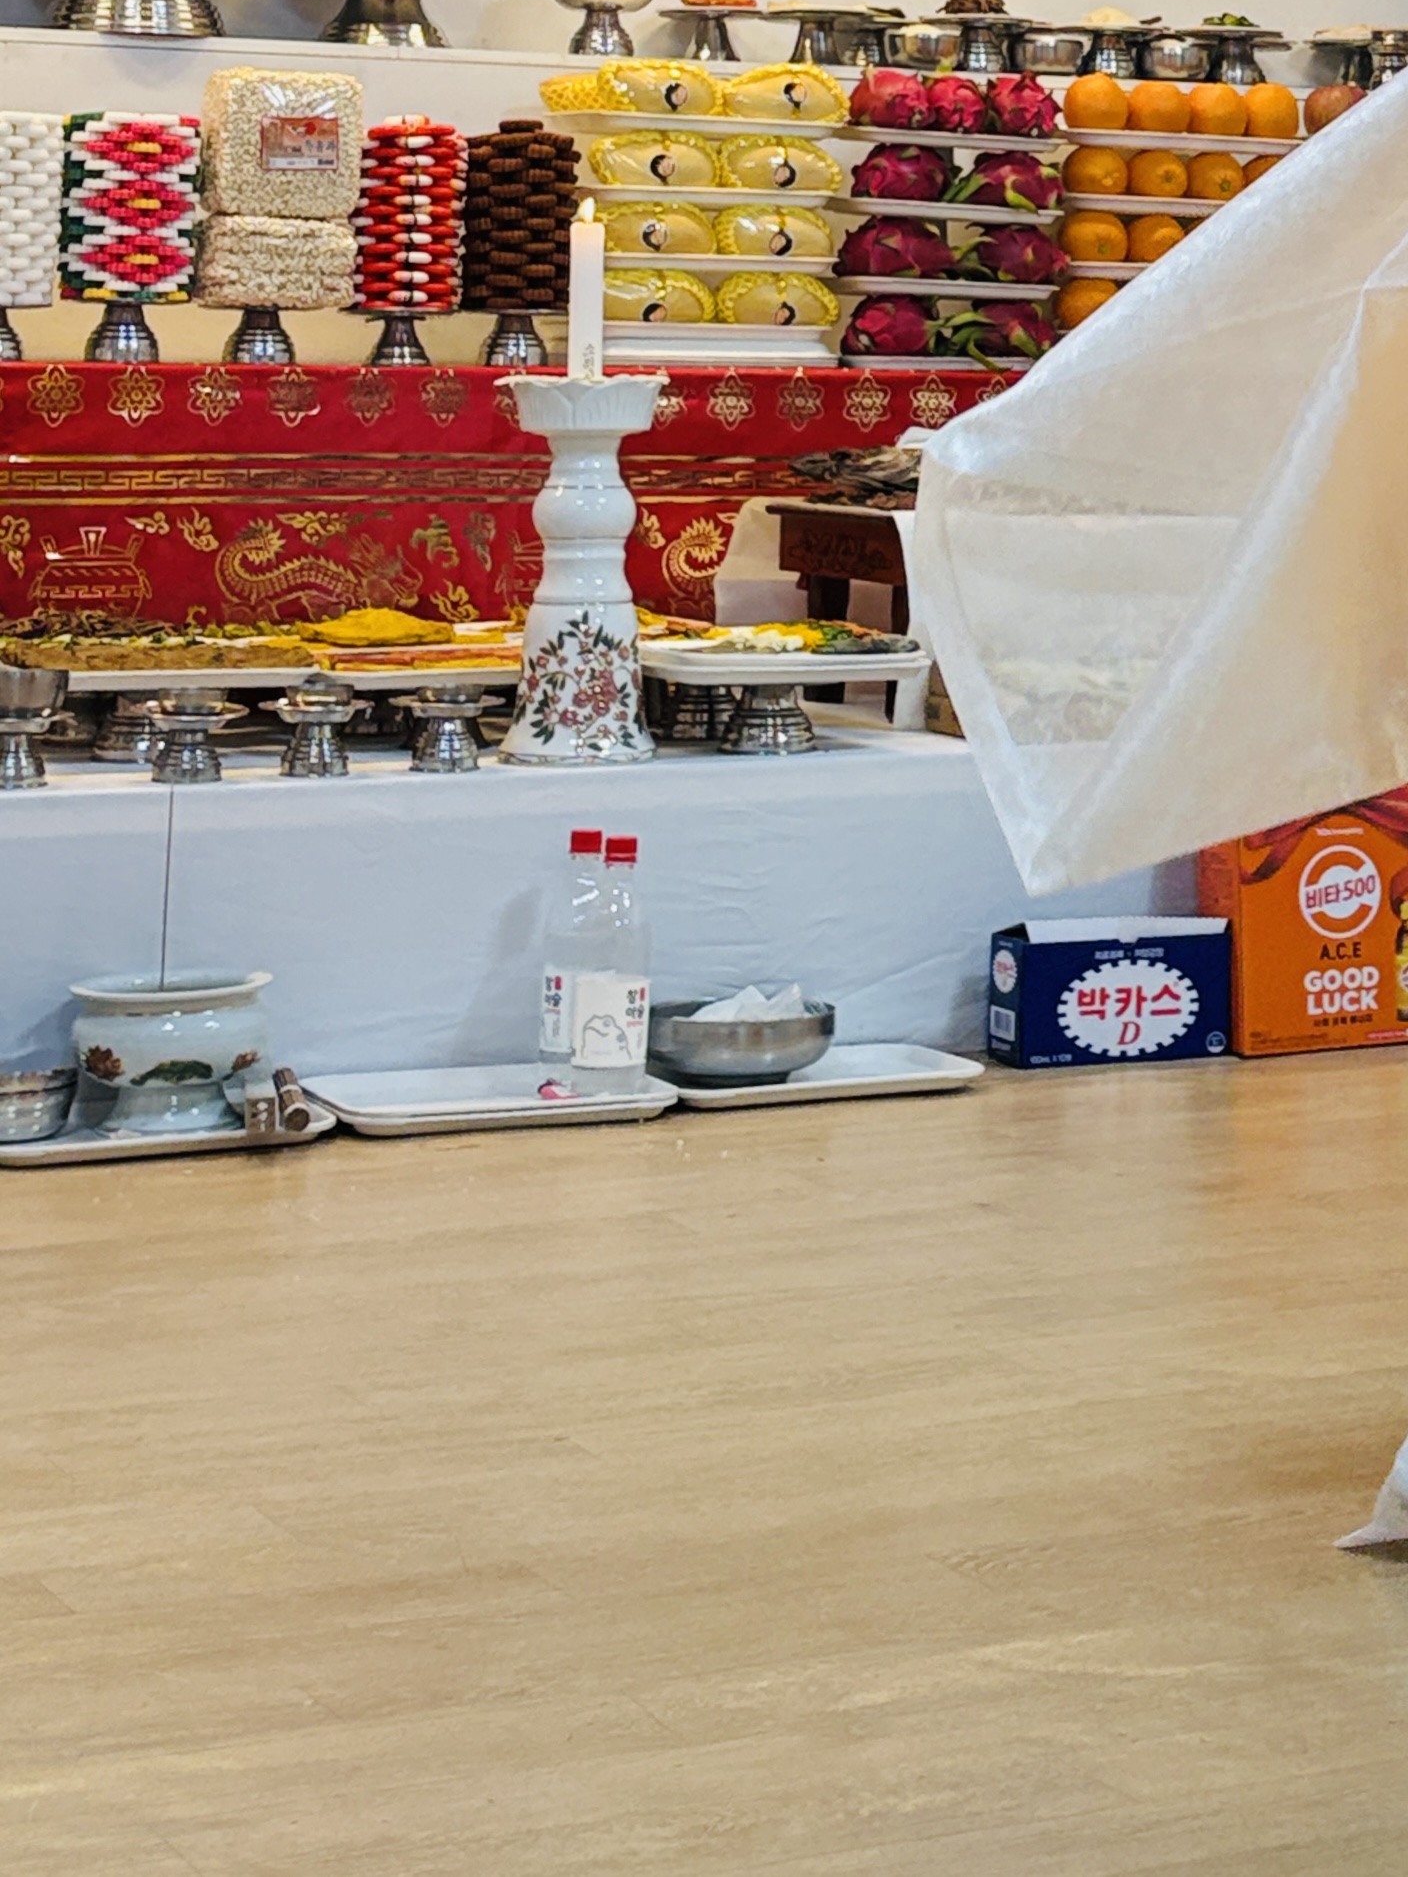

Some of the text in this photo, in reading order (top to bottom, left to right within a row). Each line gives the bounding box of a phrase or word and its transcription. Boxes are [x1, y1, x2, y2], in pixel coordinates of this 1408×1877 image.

[1305, 874, 1376, 910] 비타500
[1320, 941, 1362, 960] A.C.E
[1303, 965, 1380, 993] GOOD
[1077, 984, 1182, 1020] 박카스
[1306, 989, 1379, 1015] LUCK
[1117, 1021, 1141, 1046] D
